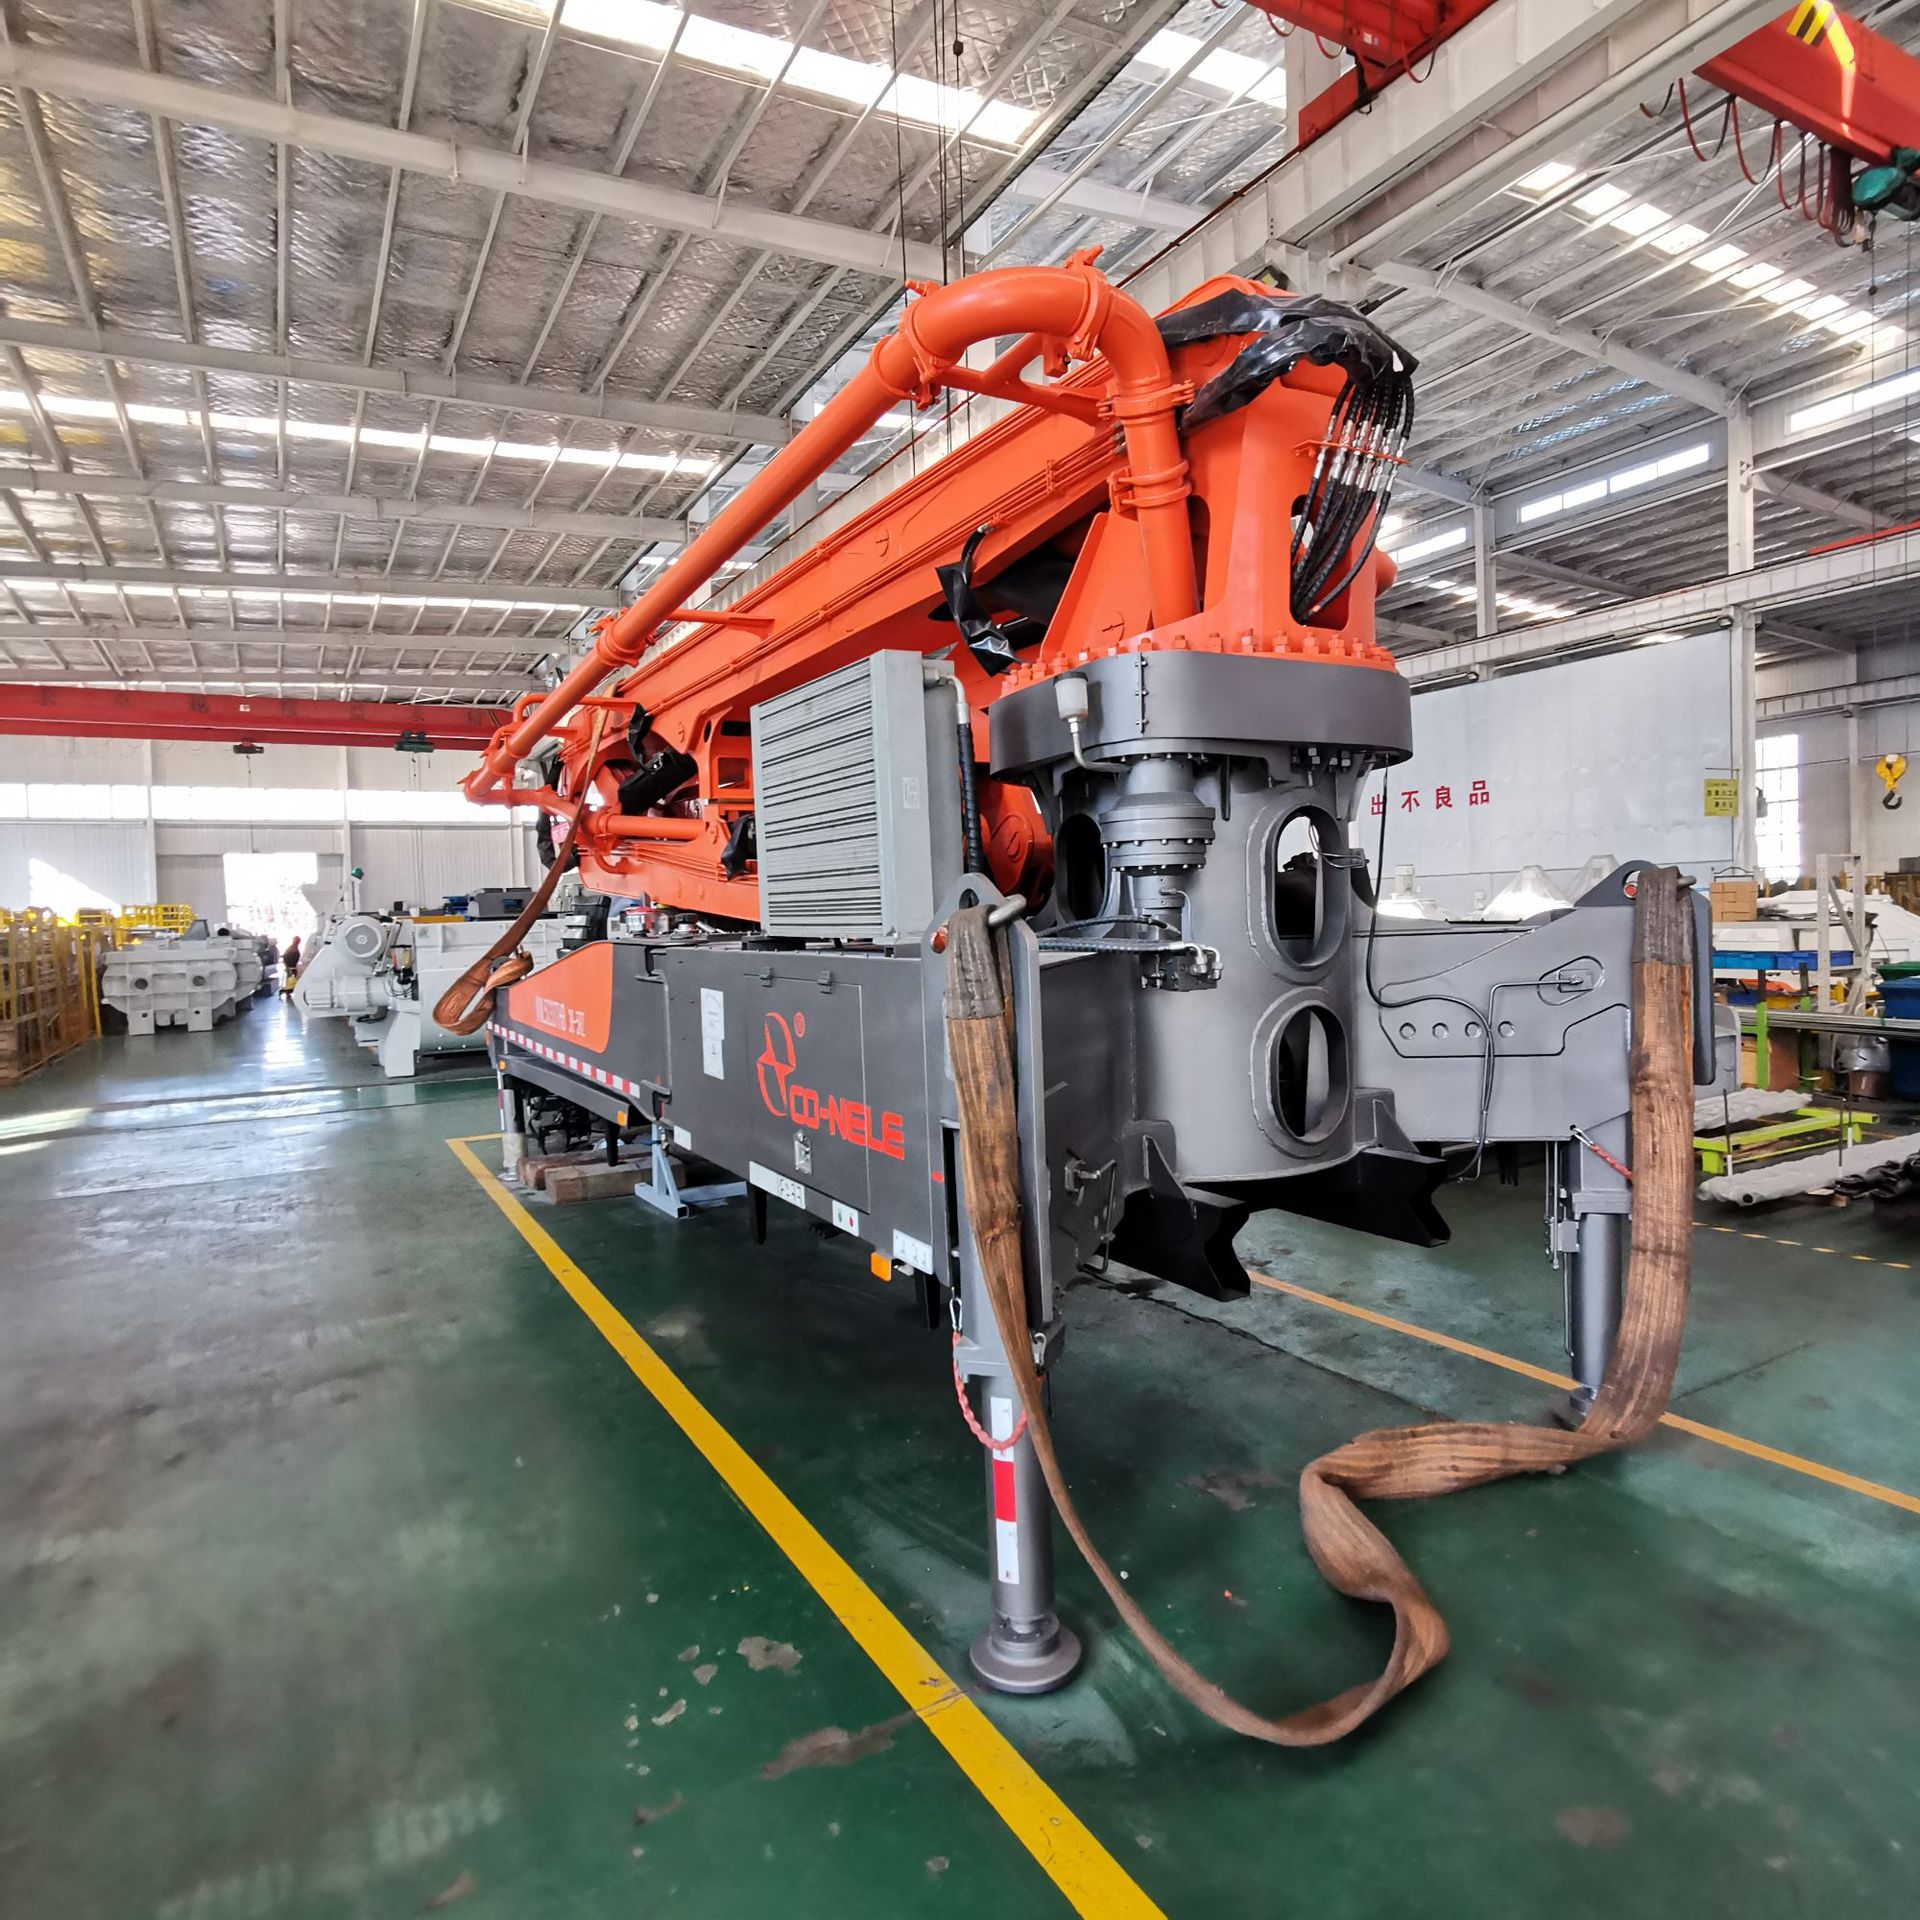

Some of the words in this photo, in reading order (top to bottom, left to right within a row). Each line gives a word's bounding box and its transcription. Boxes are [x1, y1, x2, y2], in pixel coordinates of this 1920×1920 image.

[1371, 780, 1490, 815] 出不良品
[789, 1085, 905, 1160] CO-NELE
